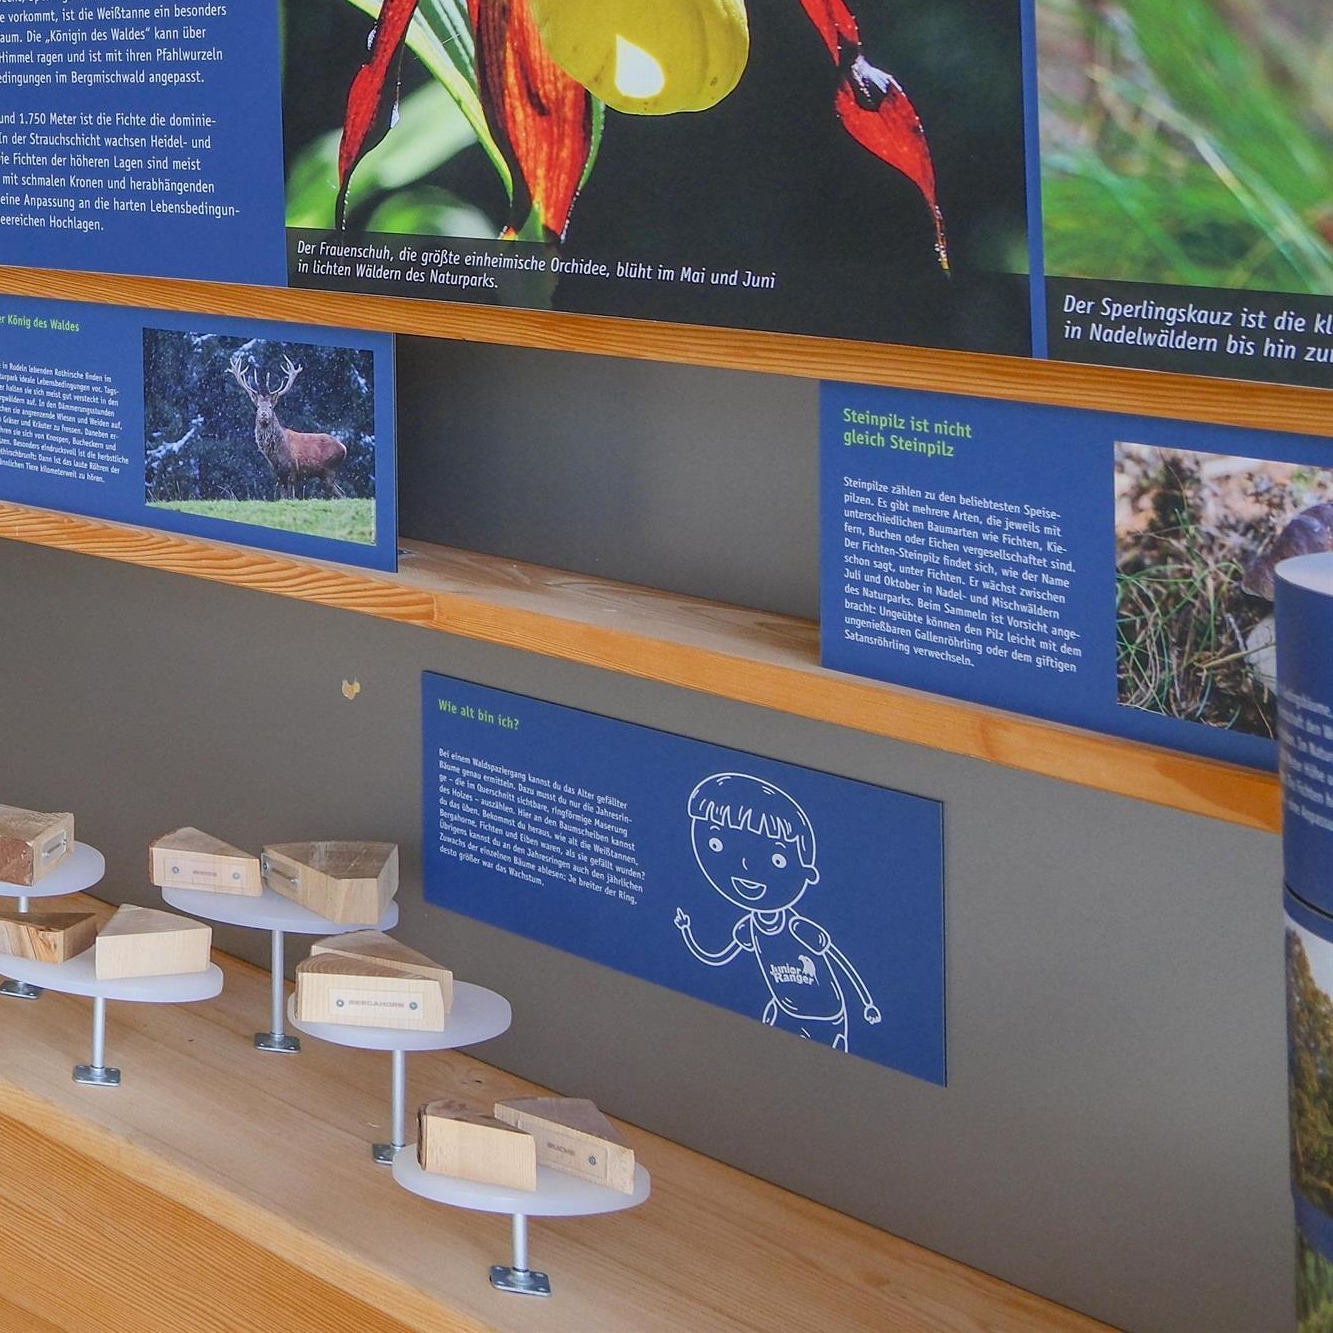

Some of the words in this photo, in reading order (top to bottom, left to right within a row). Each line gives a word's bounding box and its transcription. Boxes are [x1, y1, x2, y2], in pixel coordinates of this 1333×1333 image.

[297, 240, 316, 254] Der
[319, 241, 393, 261] Frauenschuh,
[399, 246, 417, 261] die
[420, 249, 460, 267] größte
[464, 252, 546, 271] einheimische
[550, 257, 610, 277] Orchidee,
[616, 262, 653, 279] blüht
[657, 265, 674, 280] im
[680, 267, 706, 283] Mai
[710, 271, 738, 285] und
[742, 272, 776, 288] Juni
[298, 258, 308, 273] in
[313, 260, 351, 276] lichten
[356, 263, 401, 280] Wäldern
[405, 267, 425, 282] des
[429, 269, 498, 288] Naturparks.
[7, 314, 31, 329] König
[33, 317, 47, 328] des
[49, 319, 80, 332] Waldes
[1063, 294, 1095, 314] Der
[1100, 297, 1233, 326] Sperlingskauz
[1240, 308, 1267, 329] ist
[1273, 311, 1306, 332] die
[1064, 320, 1081, 339] in
[1089, 323, 1217, 351] Nadelwäldern
[1226, 334, 1255, 355] bis
[1263, 338, 1296, 359] hin
[843, 408, 905, 429] Steinpilz
[909, 416, 929, 432] ist
[934, 420, 972, 438] nicht
[843, 429, 885, 447] gleich
[889, 434, 954, 457] Steinpilz
[843, 476, 889, 492] Steinpilze
[891, 484, 922, 497] zählen
[924, 491, 935, 500] zu
[938, 491, 956, 503] den
[959, 494, 1020, 513] beliebtesten
[1023, 504, 1061, 519] Speise-
[438, 698, 457, 714] Wie
[460, 705, 474, 719] alt
[477, 708, 494, 723] bin
[497, 714, 519, 730] ich?
[438, 747, 450, 758] Bei
[450, 752, 471, 764] einem
[472, 758, 526, 782] Waldspaziergang
[528, 773, 551, 787] kannst
[552, 780, 561, 791] du
[563, 783, 575, 794] das
[577, 788, 594, 800] Alter
[596, 795, 627, 809] gefällter
[770, 963, 801, 975] Junior
[774, 973, 814, 985] Ranger
